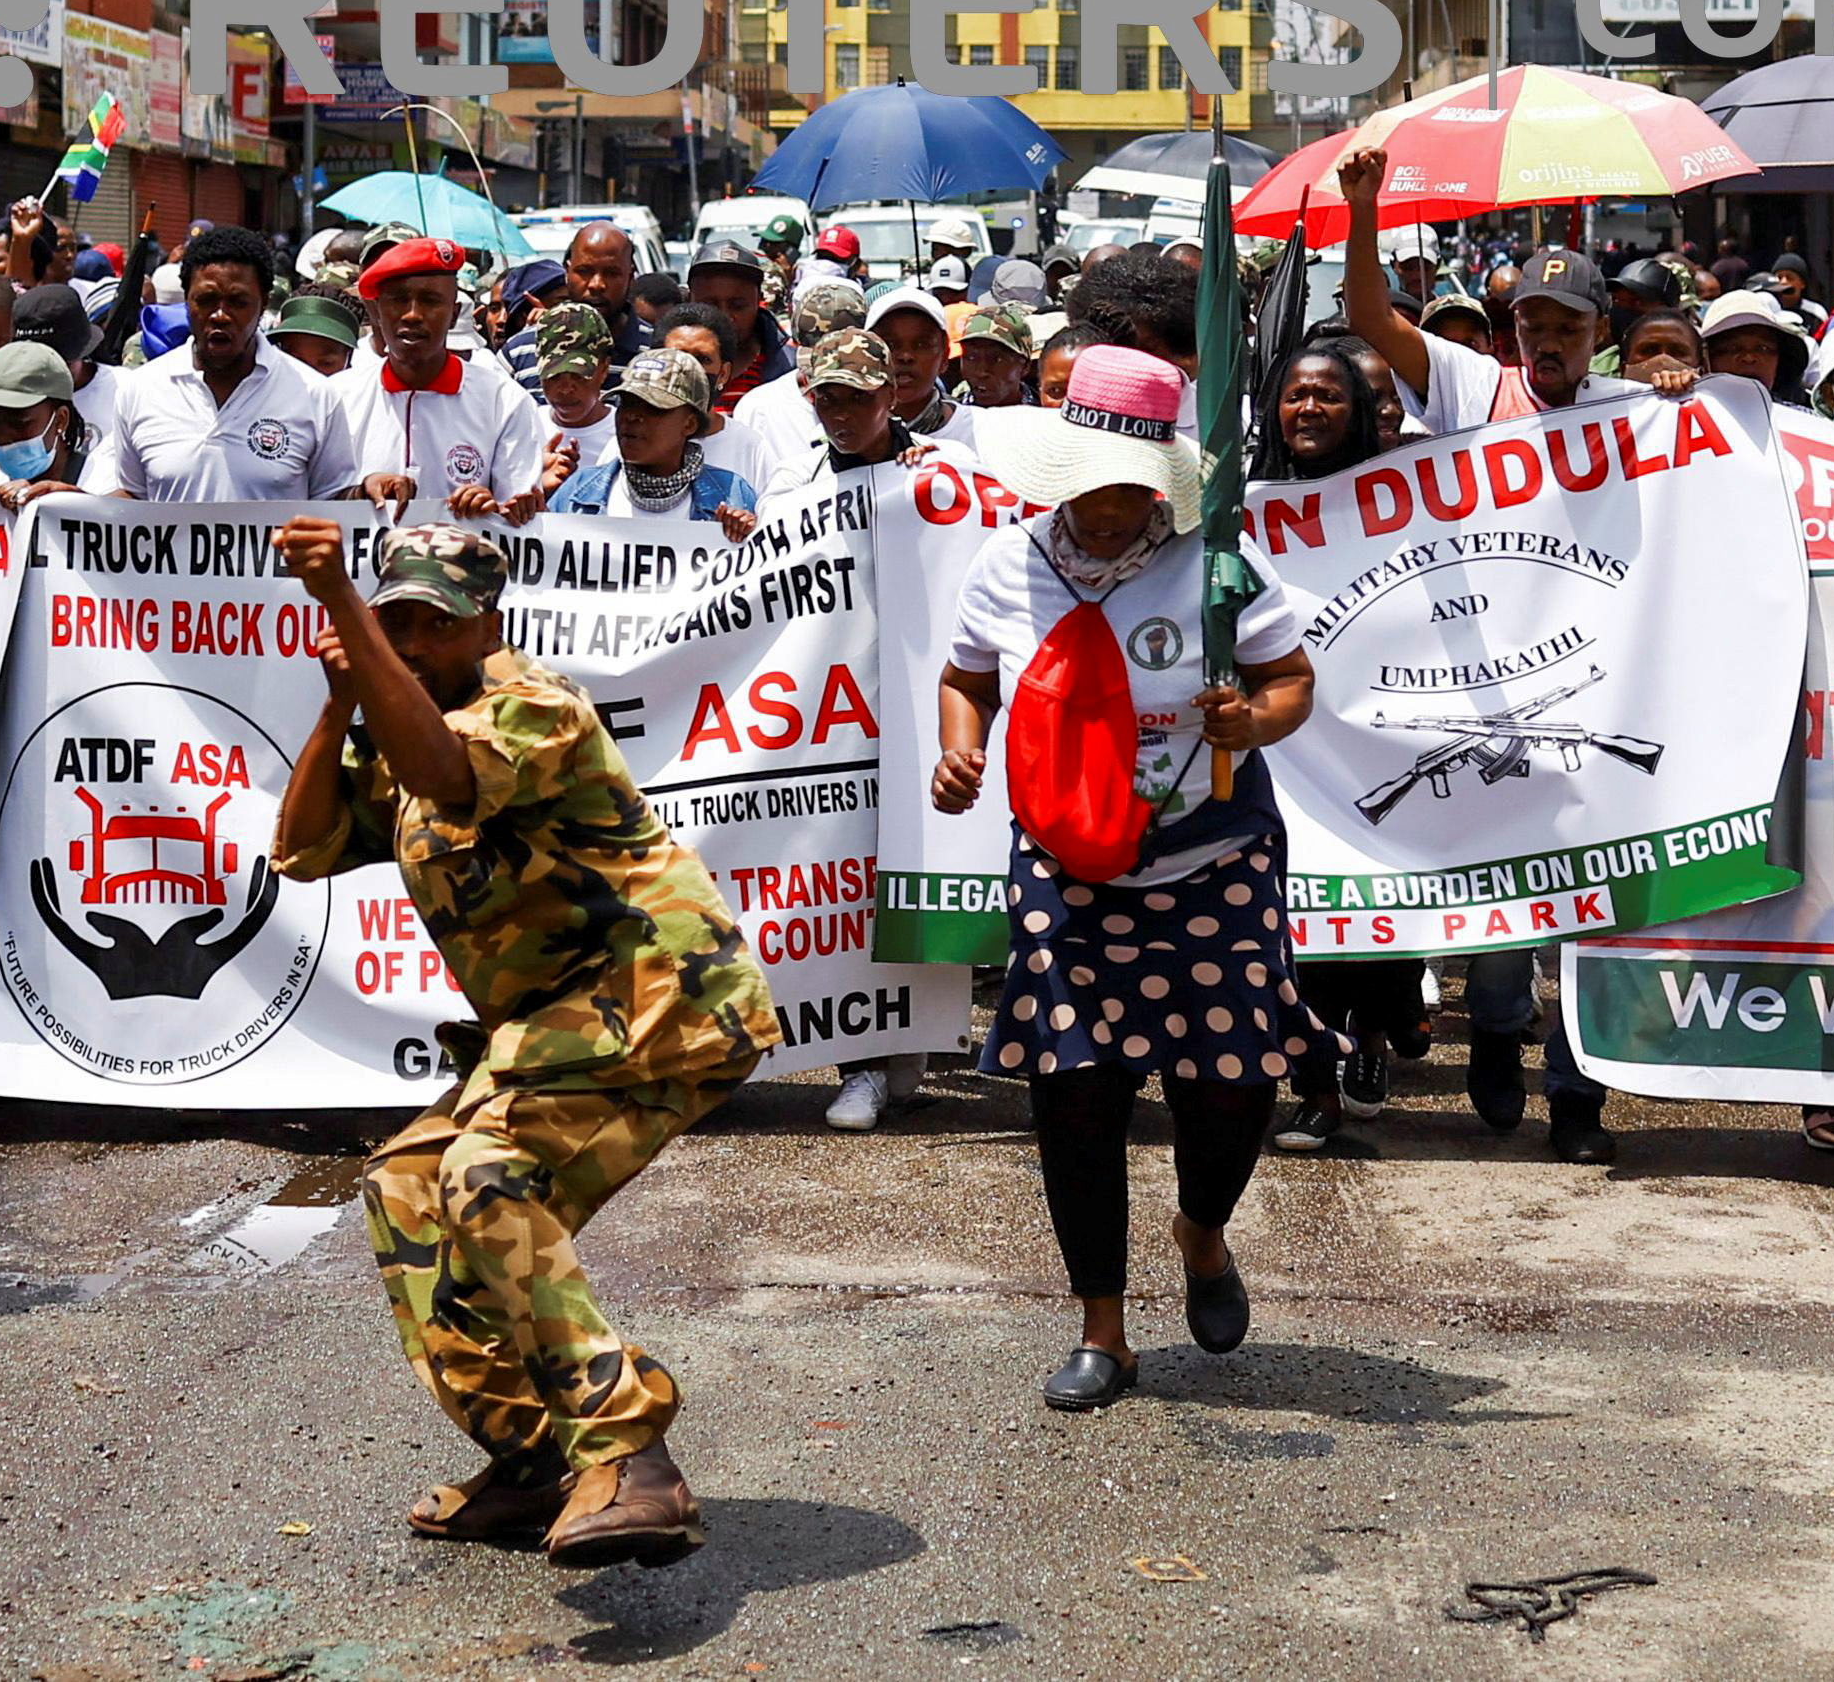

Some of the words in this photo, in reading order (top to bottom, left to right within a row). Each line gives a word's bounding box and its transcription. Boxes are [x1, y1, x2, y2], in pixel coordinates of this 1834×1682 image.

[1518, 163, 1592, 188] orijins
[1067, 406, 1109, 430] LOVE
[1120, 417, 1163, 440] LOVE
[1353, 397, 1734, 539] DUDULA
[60, 520, 178, 575] TRUCK
[554, 538, 676, 595] ALLIED
[690, 515, 791, 593] SOUTH
[51, 593, 160, 653] BRING
[171, 601, 265, 657] BACK
[587, 584, 748, 658] AFRICANS
[760, 556, 857, 621] FIRST
[1302, 541, 1441, 649] MILITARY
[1447, 531, 1631, 584] VETERANS
[1428, 592, 1490, 624] AND
[1378, 624, 1587, 689] UMPHAKATHI
[679, 663, 880, 764] ASA
[54, 738, 156, 784] ATDF
[170, 742, 252, 790] ASA
[690, 791, 761, 826] TRUCK
[766, 782, 857, 821] DRIVERS
[1339, 877, 1366, 908] A
[1371, 862, 1517, 908] BURDEN
[1523, 852, 1574, 893] ON
[1583, 838, 1658, 885] OUR
[358, 899, 416, 942] WE
[1443, 891, 1608, 942] PARK
[354, 951, 404, 995] OF
[1658, 970, 1788, 1034] We
[35, 1006, 135, 1076] POSSIBILITIES
[140, 1059, 174, 1076] FOR
[176, 1046, 236, 1076] TRUCK
[236, 982, 295, 1051] DRIVERS
[285, 968, 302, 987] IN
